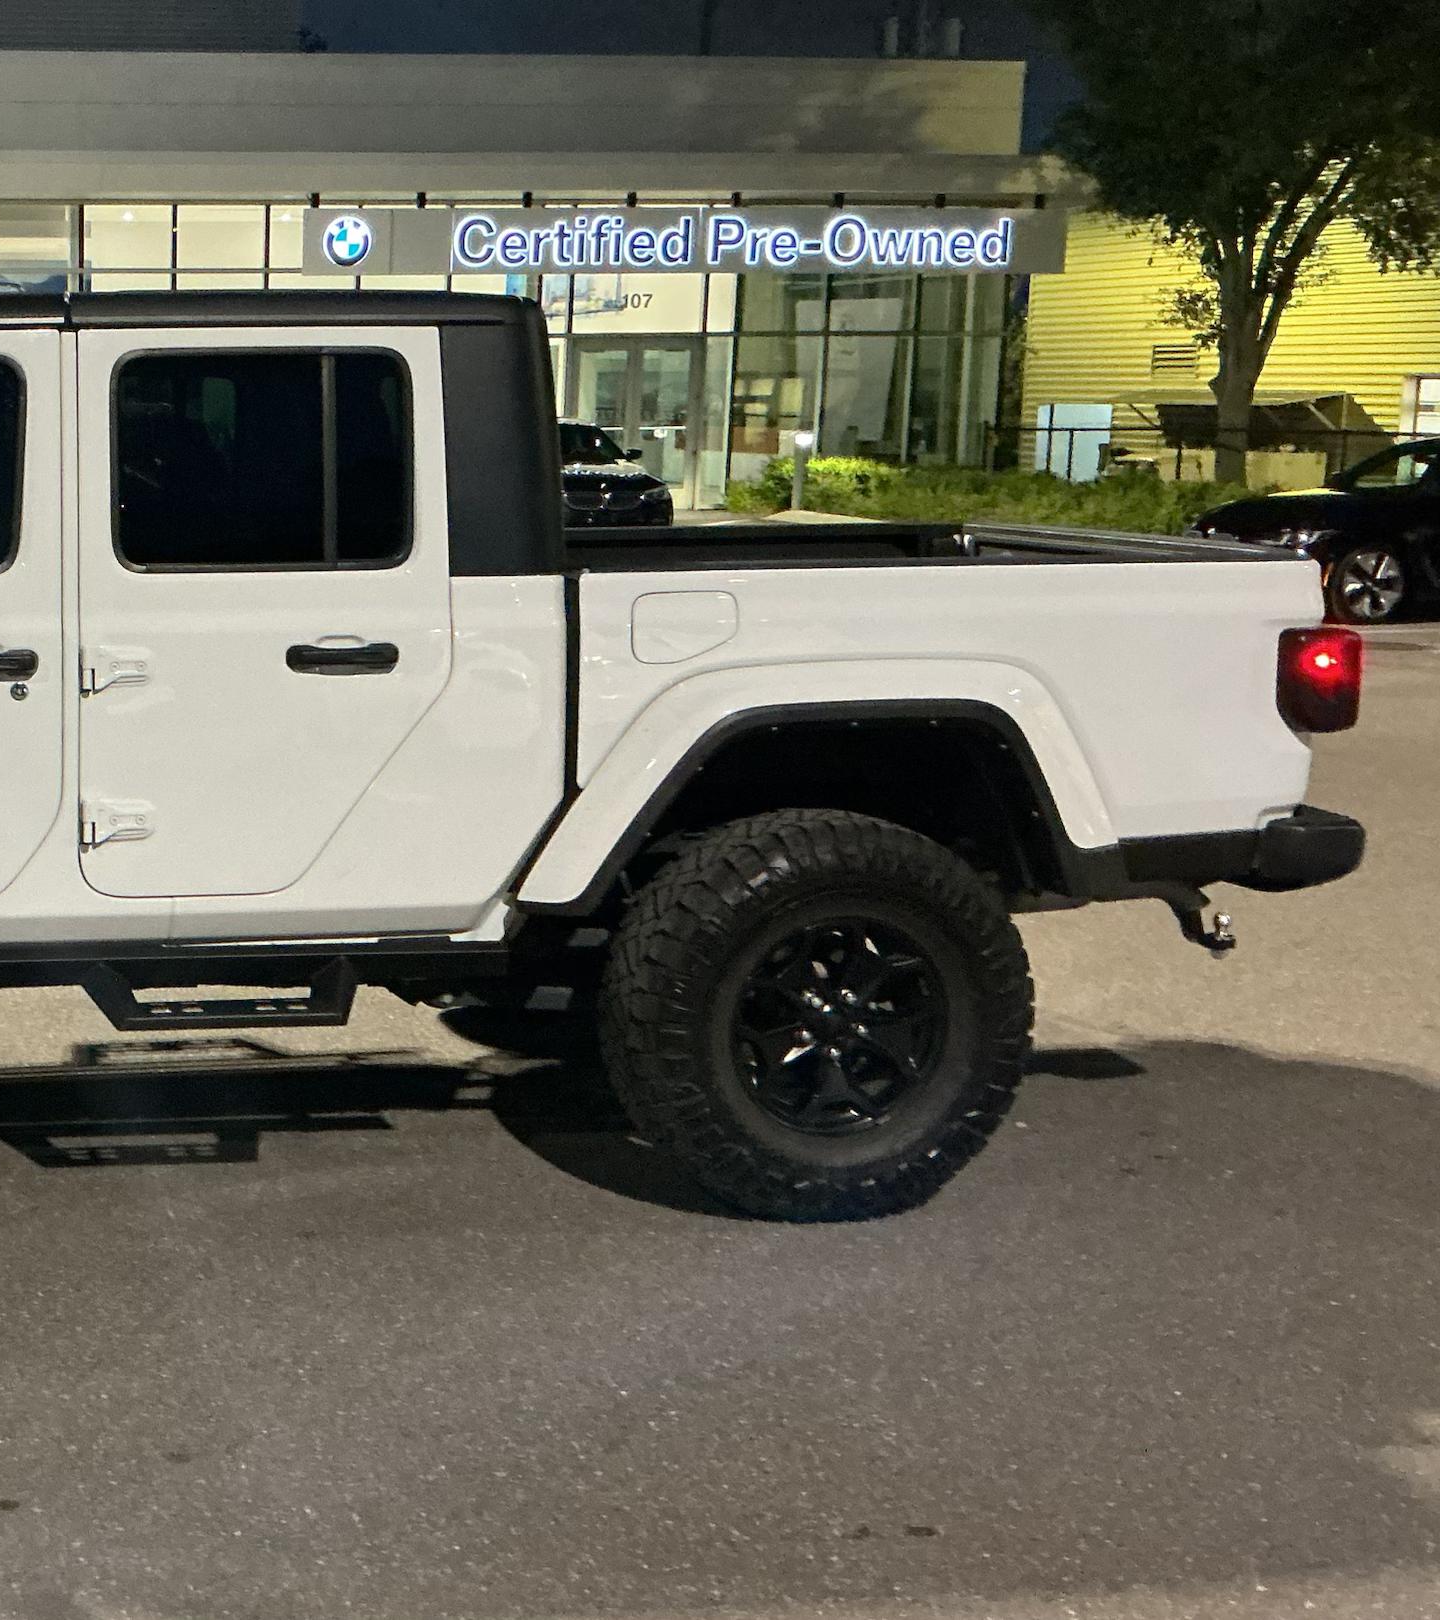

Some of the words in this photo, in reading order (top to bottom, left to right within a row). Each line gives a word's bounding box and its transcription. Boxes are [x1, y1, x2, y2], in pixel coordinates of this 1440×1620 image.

[455, 215, 693, 267] Certified
[708, 214, 1015, 266] Pre-Owned
[622, 293, 654, 309] 107
